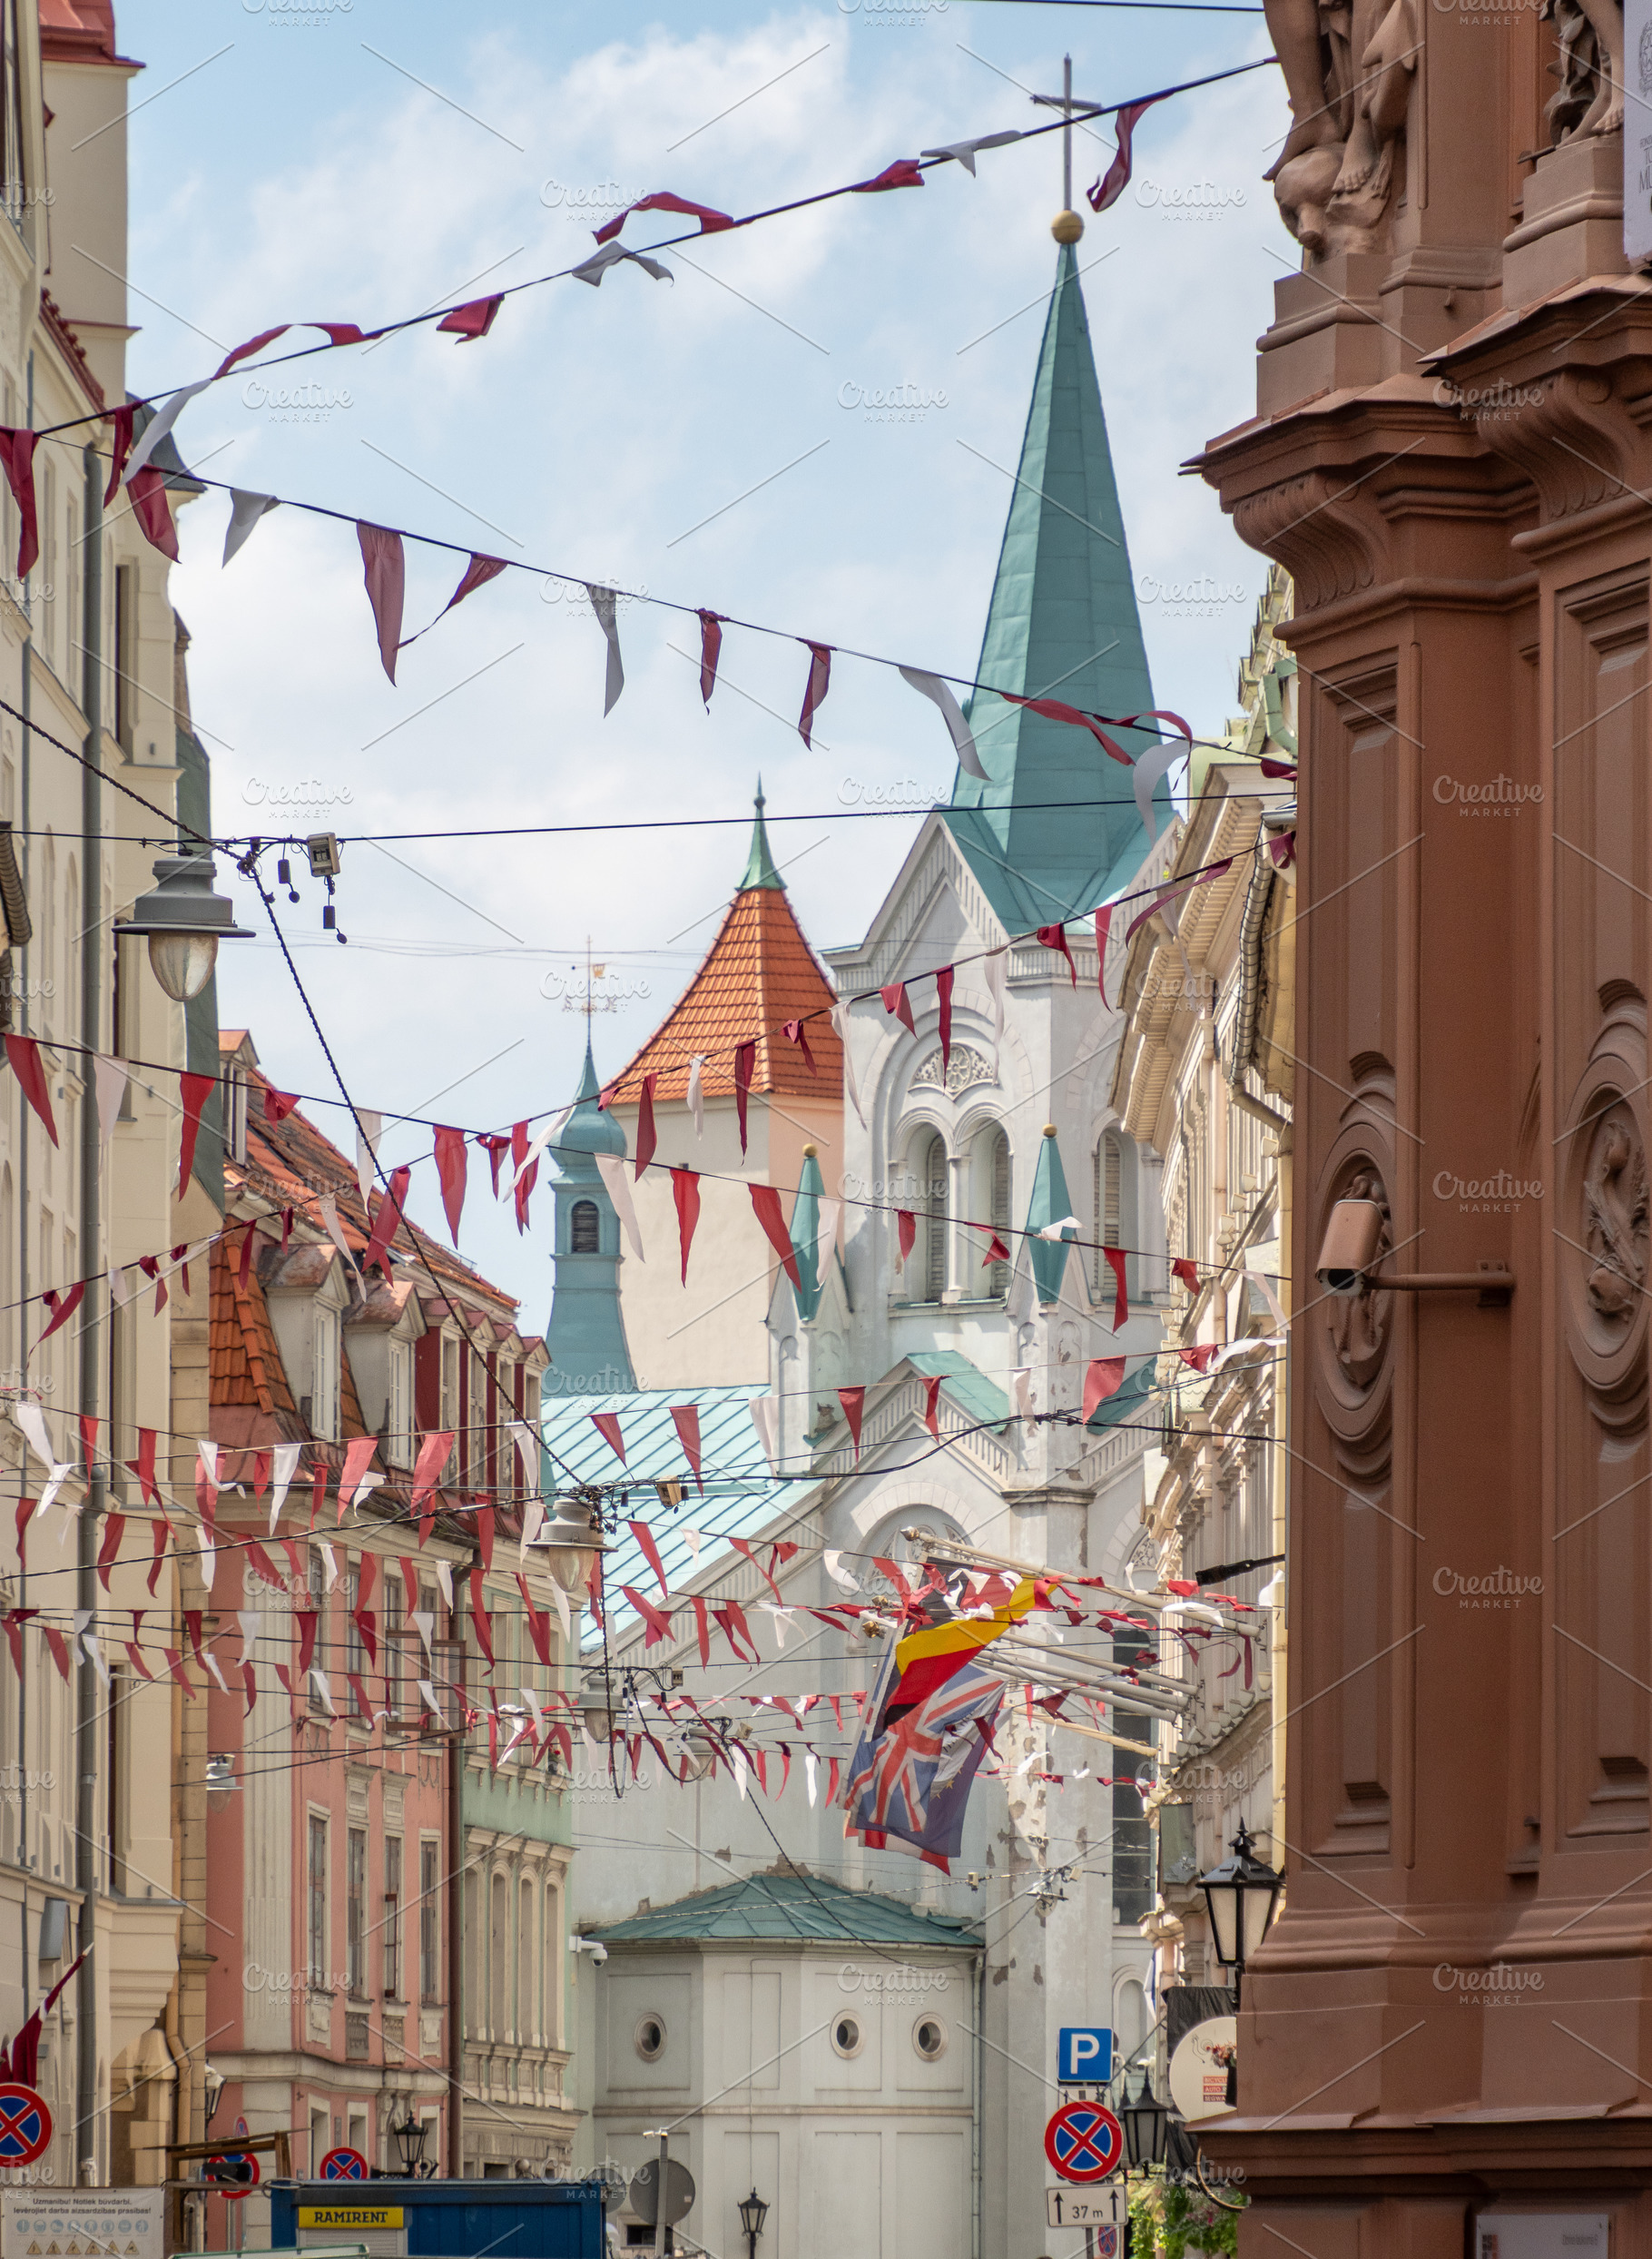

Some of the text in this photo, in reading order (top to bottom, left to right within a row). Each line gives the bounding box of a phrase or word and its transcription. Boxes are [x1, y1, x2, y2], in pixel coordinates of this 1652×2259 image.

[1070, 2033, 1100, 2075] P
[314, 2212, 388, 2223] RAMIRENT
[1072, 2205, 1104, 2219] 37 m
